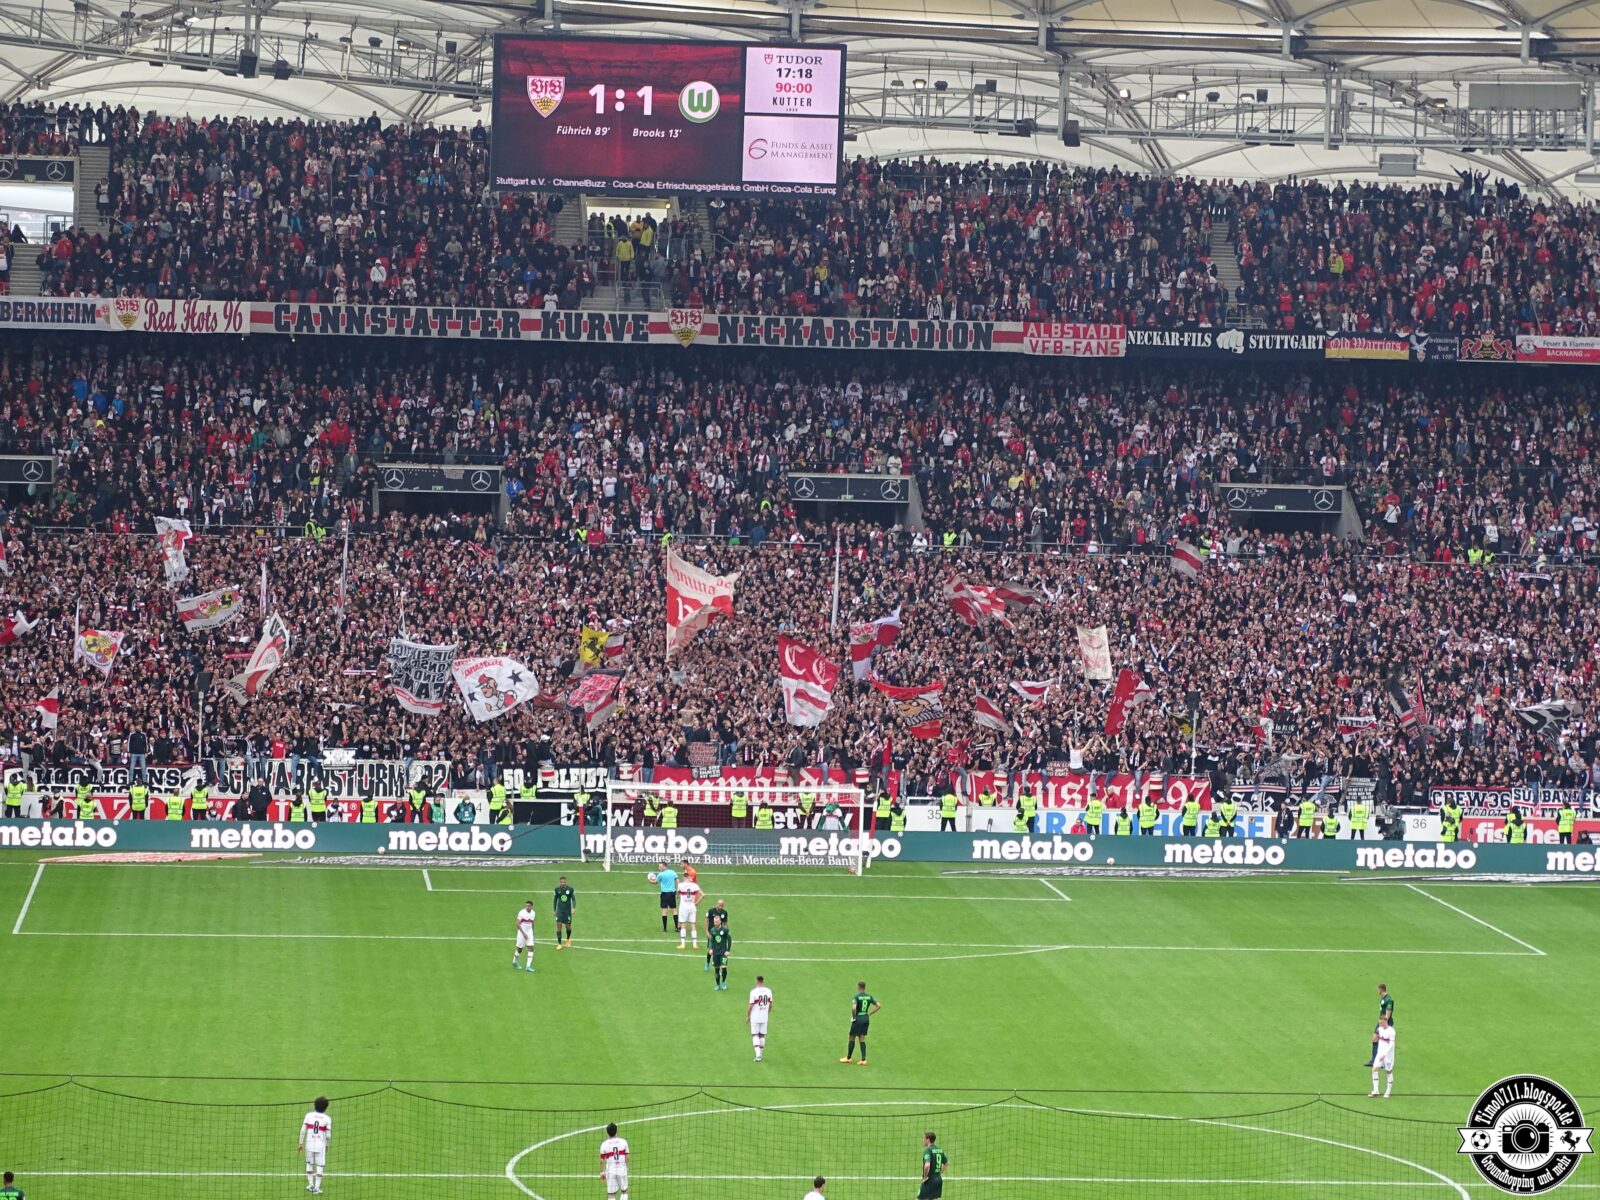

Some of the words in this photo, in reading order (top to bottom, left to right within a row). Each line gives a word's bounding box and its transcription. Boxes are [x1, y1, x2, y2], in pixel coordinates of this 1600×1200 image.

[776, 55, 823, 65] TUDOR
[776, 68, 813, 79] 17:18
[775, 82, 813, 93] 90:00
[772, 96, 812, 107] KUTTER
[556, 125, 592, 136] Führich
[632, 128, 665, 137] Brooks
[552, 178, 606, 188] ChannelBuzz
[612, 180, 654, 189] Coca-Cola
[656, 180, 741, 192] Erfrischungsgetränke
[743, 183, 769, 192] GmbH
[770, 185, 812, 193] Coca-Cola
[144, 301, 177, 332] Red
[182, 301, 218, 332] Hots
[223, 300, 243, 332] 96
[274, 304, 521, 339] CANNSTATTER
[541, 311, 649, 342] KURVE
[717, 315, 994, 351] NECKARSTADION
[1026, 323, 1122, 340] ALBSTADT
[1028, 338, 1120, 356] VFB-FANS
[1127, 330, 1212, 348] NECKAR-FILS
[1249, 333, 1326, 350] STUTTGART
[1330, 337, 1350, 350] Old
[1352, 337, 1401, 351] Warriors
[1546, 349, 1583, 357] BACKNANG
[1488, 791, 1511, 808] 36
[927, 809, 942, 819] 35
[1412, 818, 1427, 829] 36
[190, 823, 316, 850] metabo
[388, 826, 513, 852] metabo
[585, 829, 708, 854] metabo
[973, 836, 1094, 861] metabo
[1164, 839, 1286, 865] metabo
[1356, 843, 1476, 869] metabo
[618, 853, 701, 864] Mercedes-Benz
[703, 854, 732, 865] Bank
[742, 855, 825, 866] Mercedes-Benz
[828, 856, 856, 866] Bank
[758, 995, 768, 1007] 20
